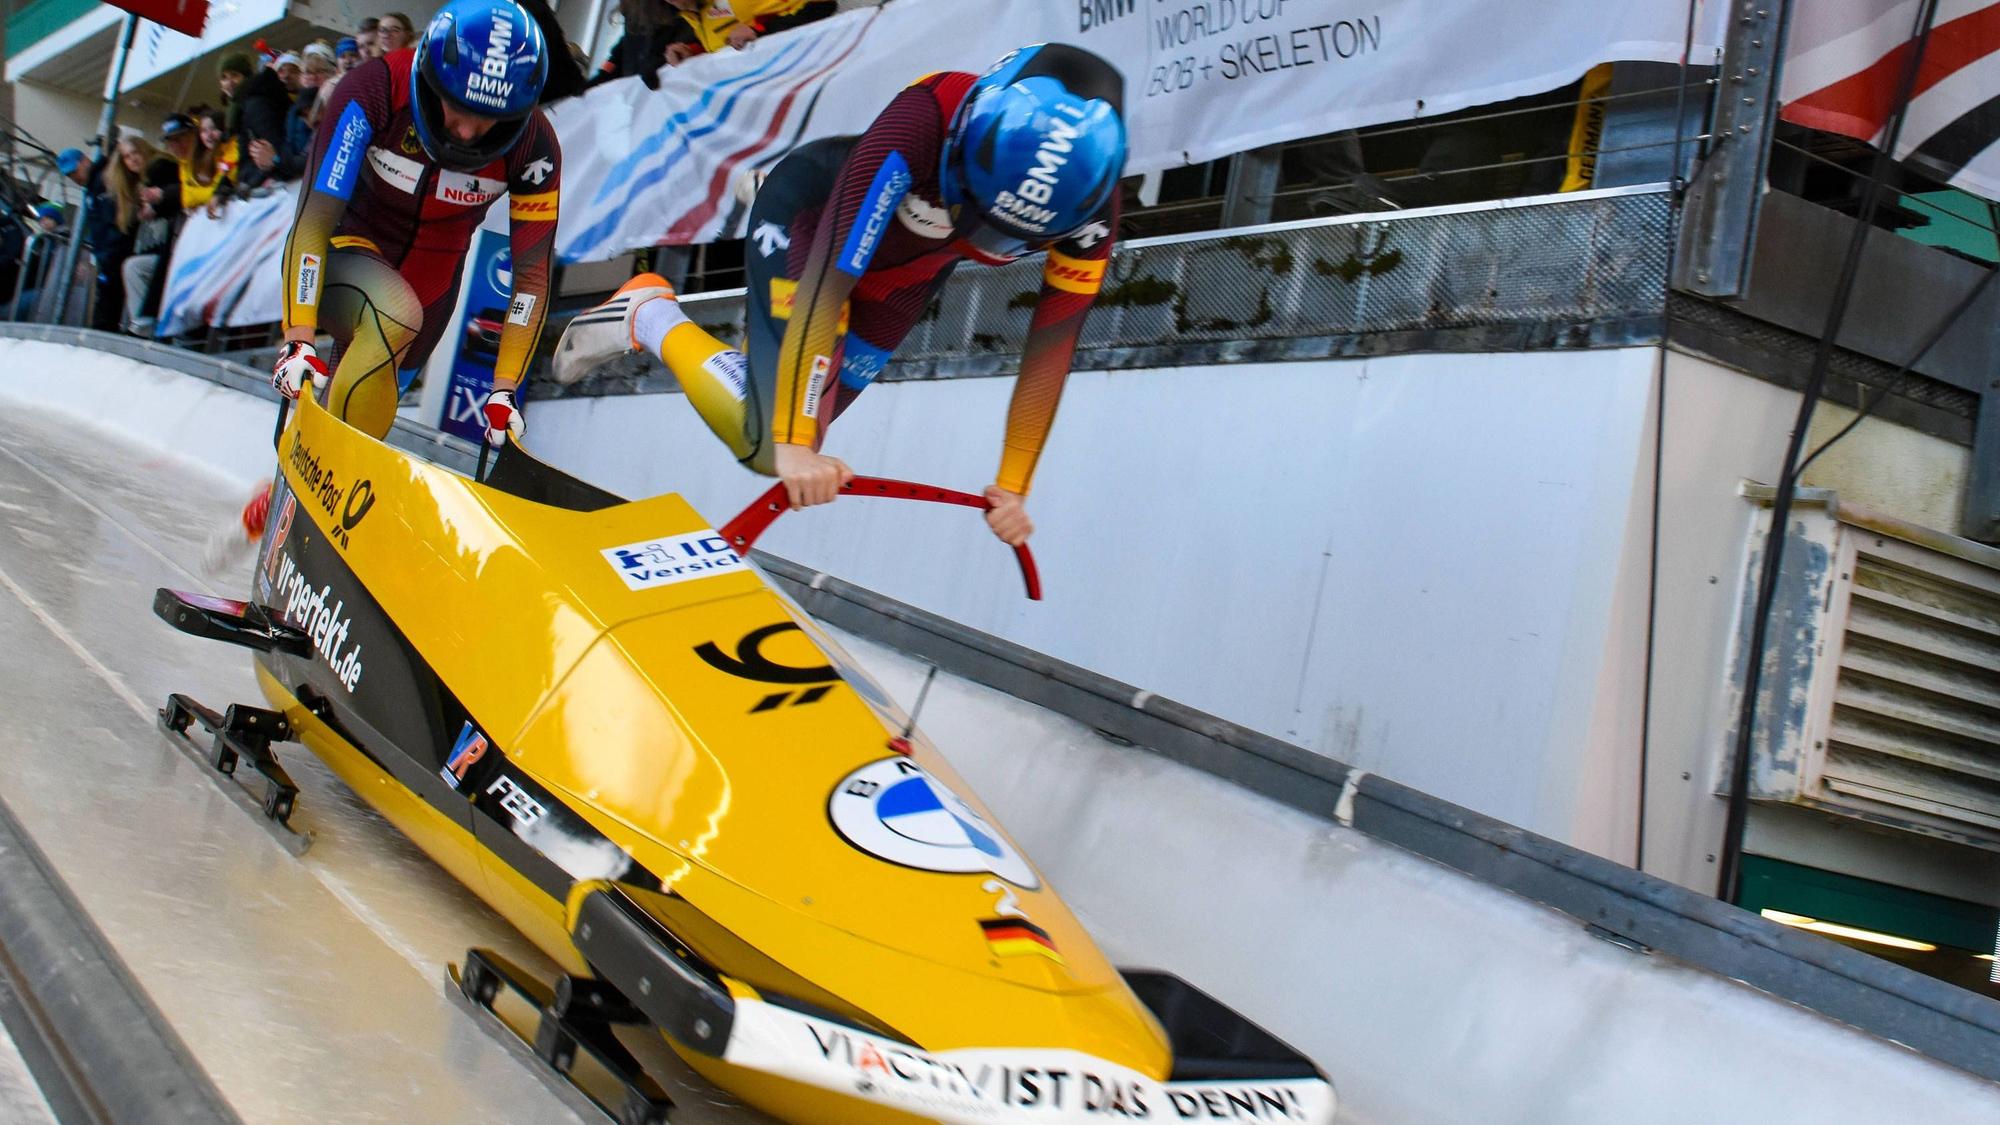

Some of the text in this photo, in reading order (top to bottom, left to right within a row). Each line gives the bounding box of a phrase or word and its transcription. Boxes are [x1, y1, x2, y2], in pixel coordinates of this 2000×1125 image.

[483, 8, 513, 79] BMW i
[1156, 0, 1236, 50] WORLD
[1147, 56, 1196, 97] BOB
[1219, 15, 1382, 80] SKELETON
[465, 88, 507, 109] helmets
[467, 72, 513, 97] BMW
[1016, 102, 1087, 205] BMW i
[994, 190, 1058, 224] BMW
[300, 268, 311, 303] Sporthilfe
[449, 385, 490, 428] iX
[290, 430, 345, 517] Deutsche Post
[277, 552, 362, 693] vr-perfekt.de
[486, 774, 549, 827] FES
[981, 878, 1031, 919] 2
[806, 1022, 992, 1099] VIACTIV
[1001, 1065, 1072, 1108] IST
[1082, 1070, 1151, 1120] DAS
[1165, 1087, 1306, 1119] DENN!
